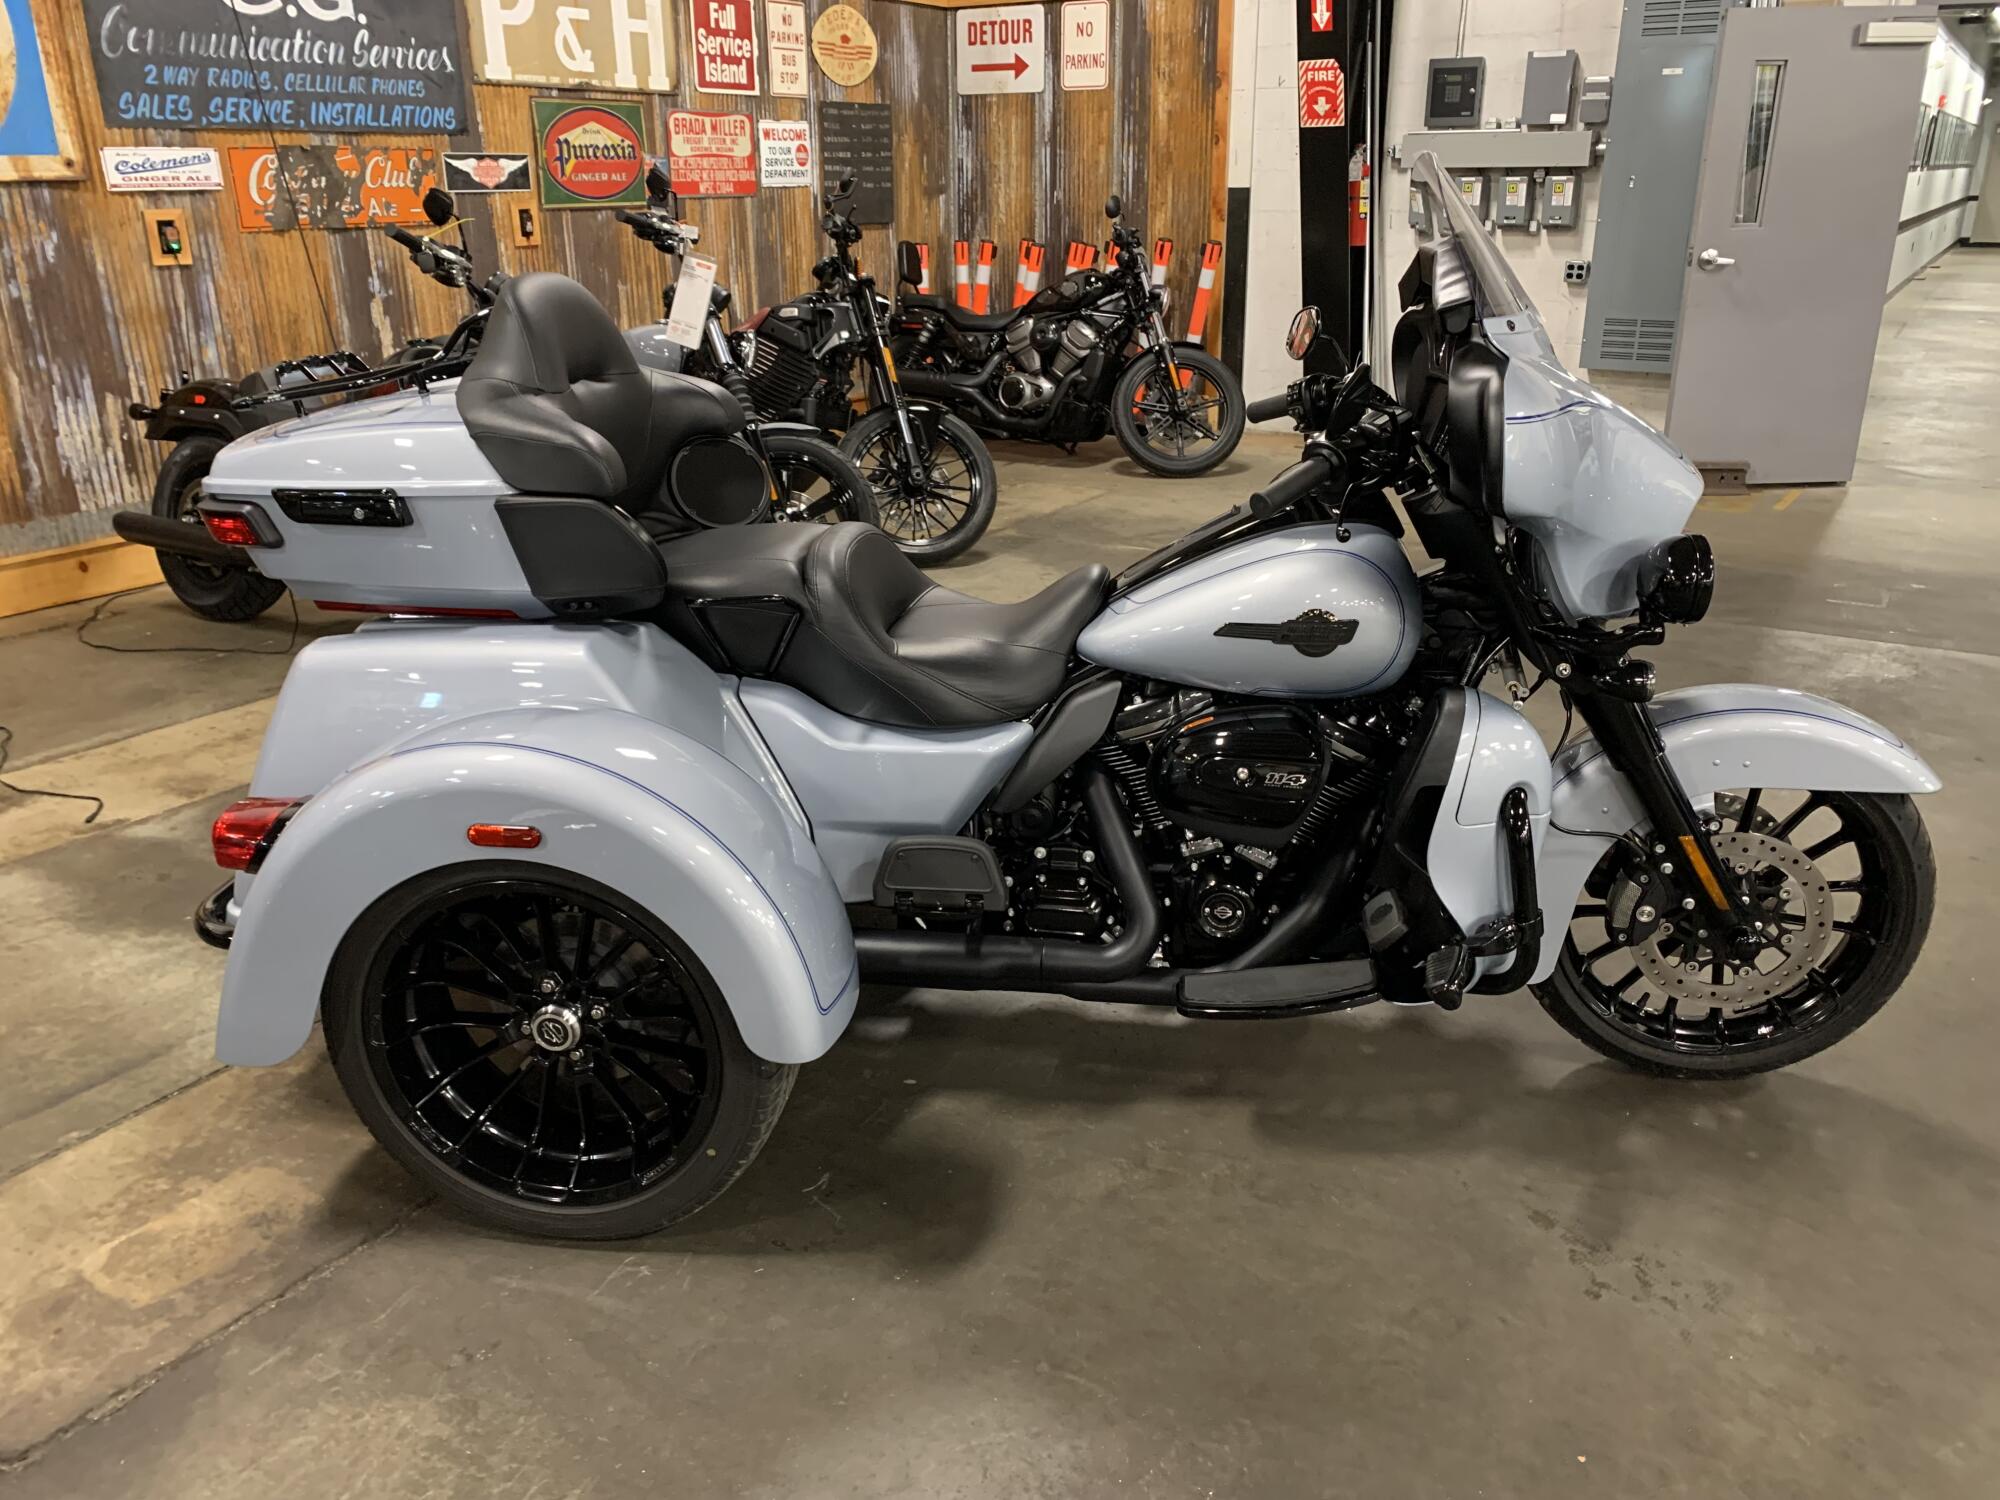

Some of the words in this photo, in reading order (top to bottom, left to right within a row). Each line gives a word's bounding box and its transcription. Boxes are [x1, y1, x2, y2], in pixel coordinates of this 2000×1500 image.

[709, 2, 737, 31] Full
[781, 13, 793, 27] NO
[968, 18, 1033, 46] DETOUR
[1076, 21, 1093, 37] NO
[100, 4, 345, 65] Comunication
[352, 29, 455, 73] Services
[480, 0, 535, 80] P
[555, 6, 595, 73] &
[610, 0, 670, 91] H
[698, 27, 751, 59] Service
[771, 30, 804, 46] PARKING
[781, 54, 797, 67] BUS
[1065, 52, 1105, 70] PARKING
[704, 55, 748, 85] Island
[780, 72, 799, 85] STOP
[1307, 70, 1336, 82] FIRE
[144, 64, 159, 85] 2
[163, 65, 200, 87] WAY
[371, 77, 426, 97] PHONES
[311, 101, 457, 129] INSTALLATIONS
[673, 117, 706, 136] BRADA
[710, 119, 746, 137] MILLER
[762, 128, 807, 141] WELCOME
[552, 137, 637, 178] Pureoxia
[768, 146, 777, 155] TO
[779, 147, 792, 155] OUR
[114, 152, 212, 175] Coleman's
[765, 158, 794, 167] SERVICE
[571, 172, 608, 182] GINGER
[611, 172, 628, 182] ALE
[764, 169, 808, 178] DEPARTMENT
[1264, 772, 1307, 786] 114
